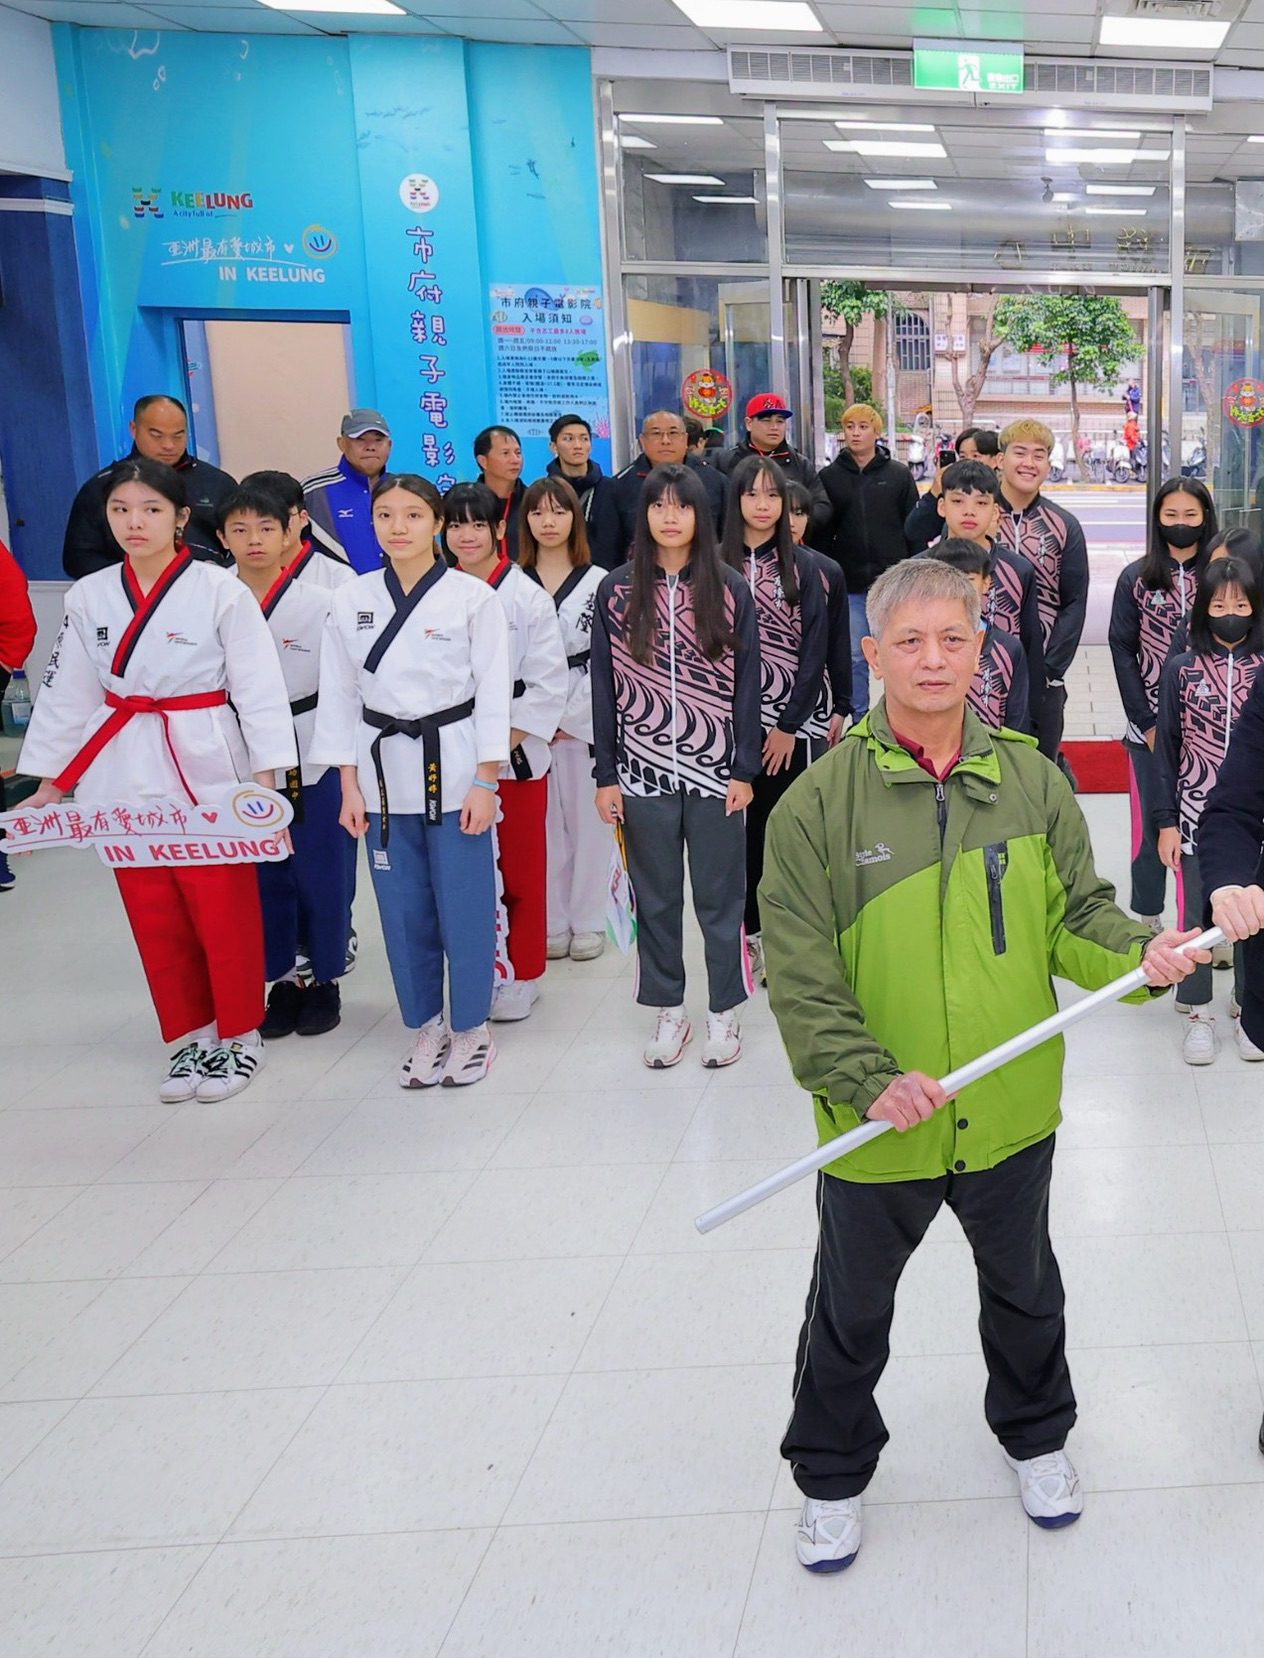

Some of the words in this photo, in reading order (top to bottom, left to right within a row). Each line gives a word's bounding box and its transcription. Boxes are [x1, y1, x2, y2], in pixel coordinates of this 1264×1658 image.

[171, 191, 253, 210] KEELUNG
[219, 266, 236, 281] IN
[247, 267, 326, 283] KEELUNG
[501, 296, 592, 310] 市府親子電影院
[522, 312, 572, 324] 入場須知
[104, 845, 136, 863] IN
[150, 839, 280, 862] KEELUNG
